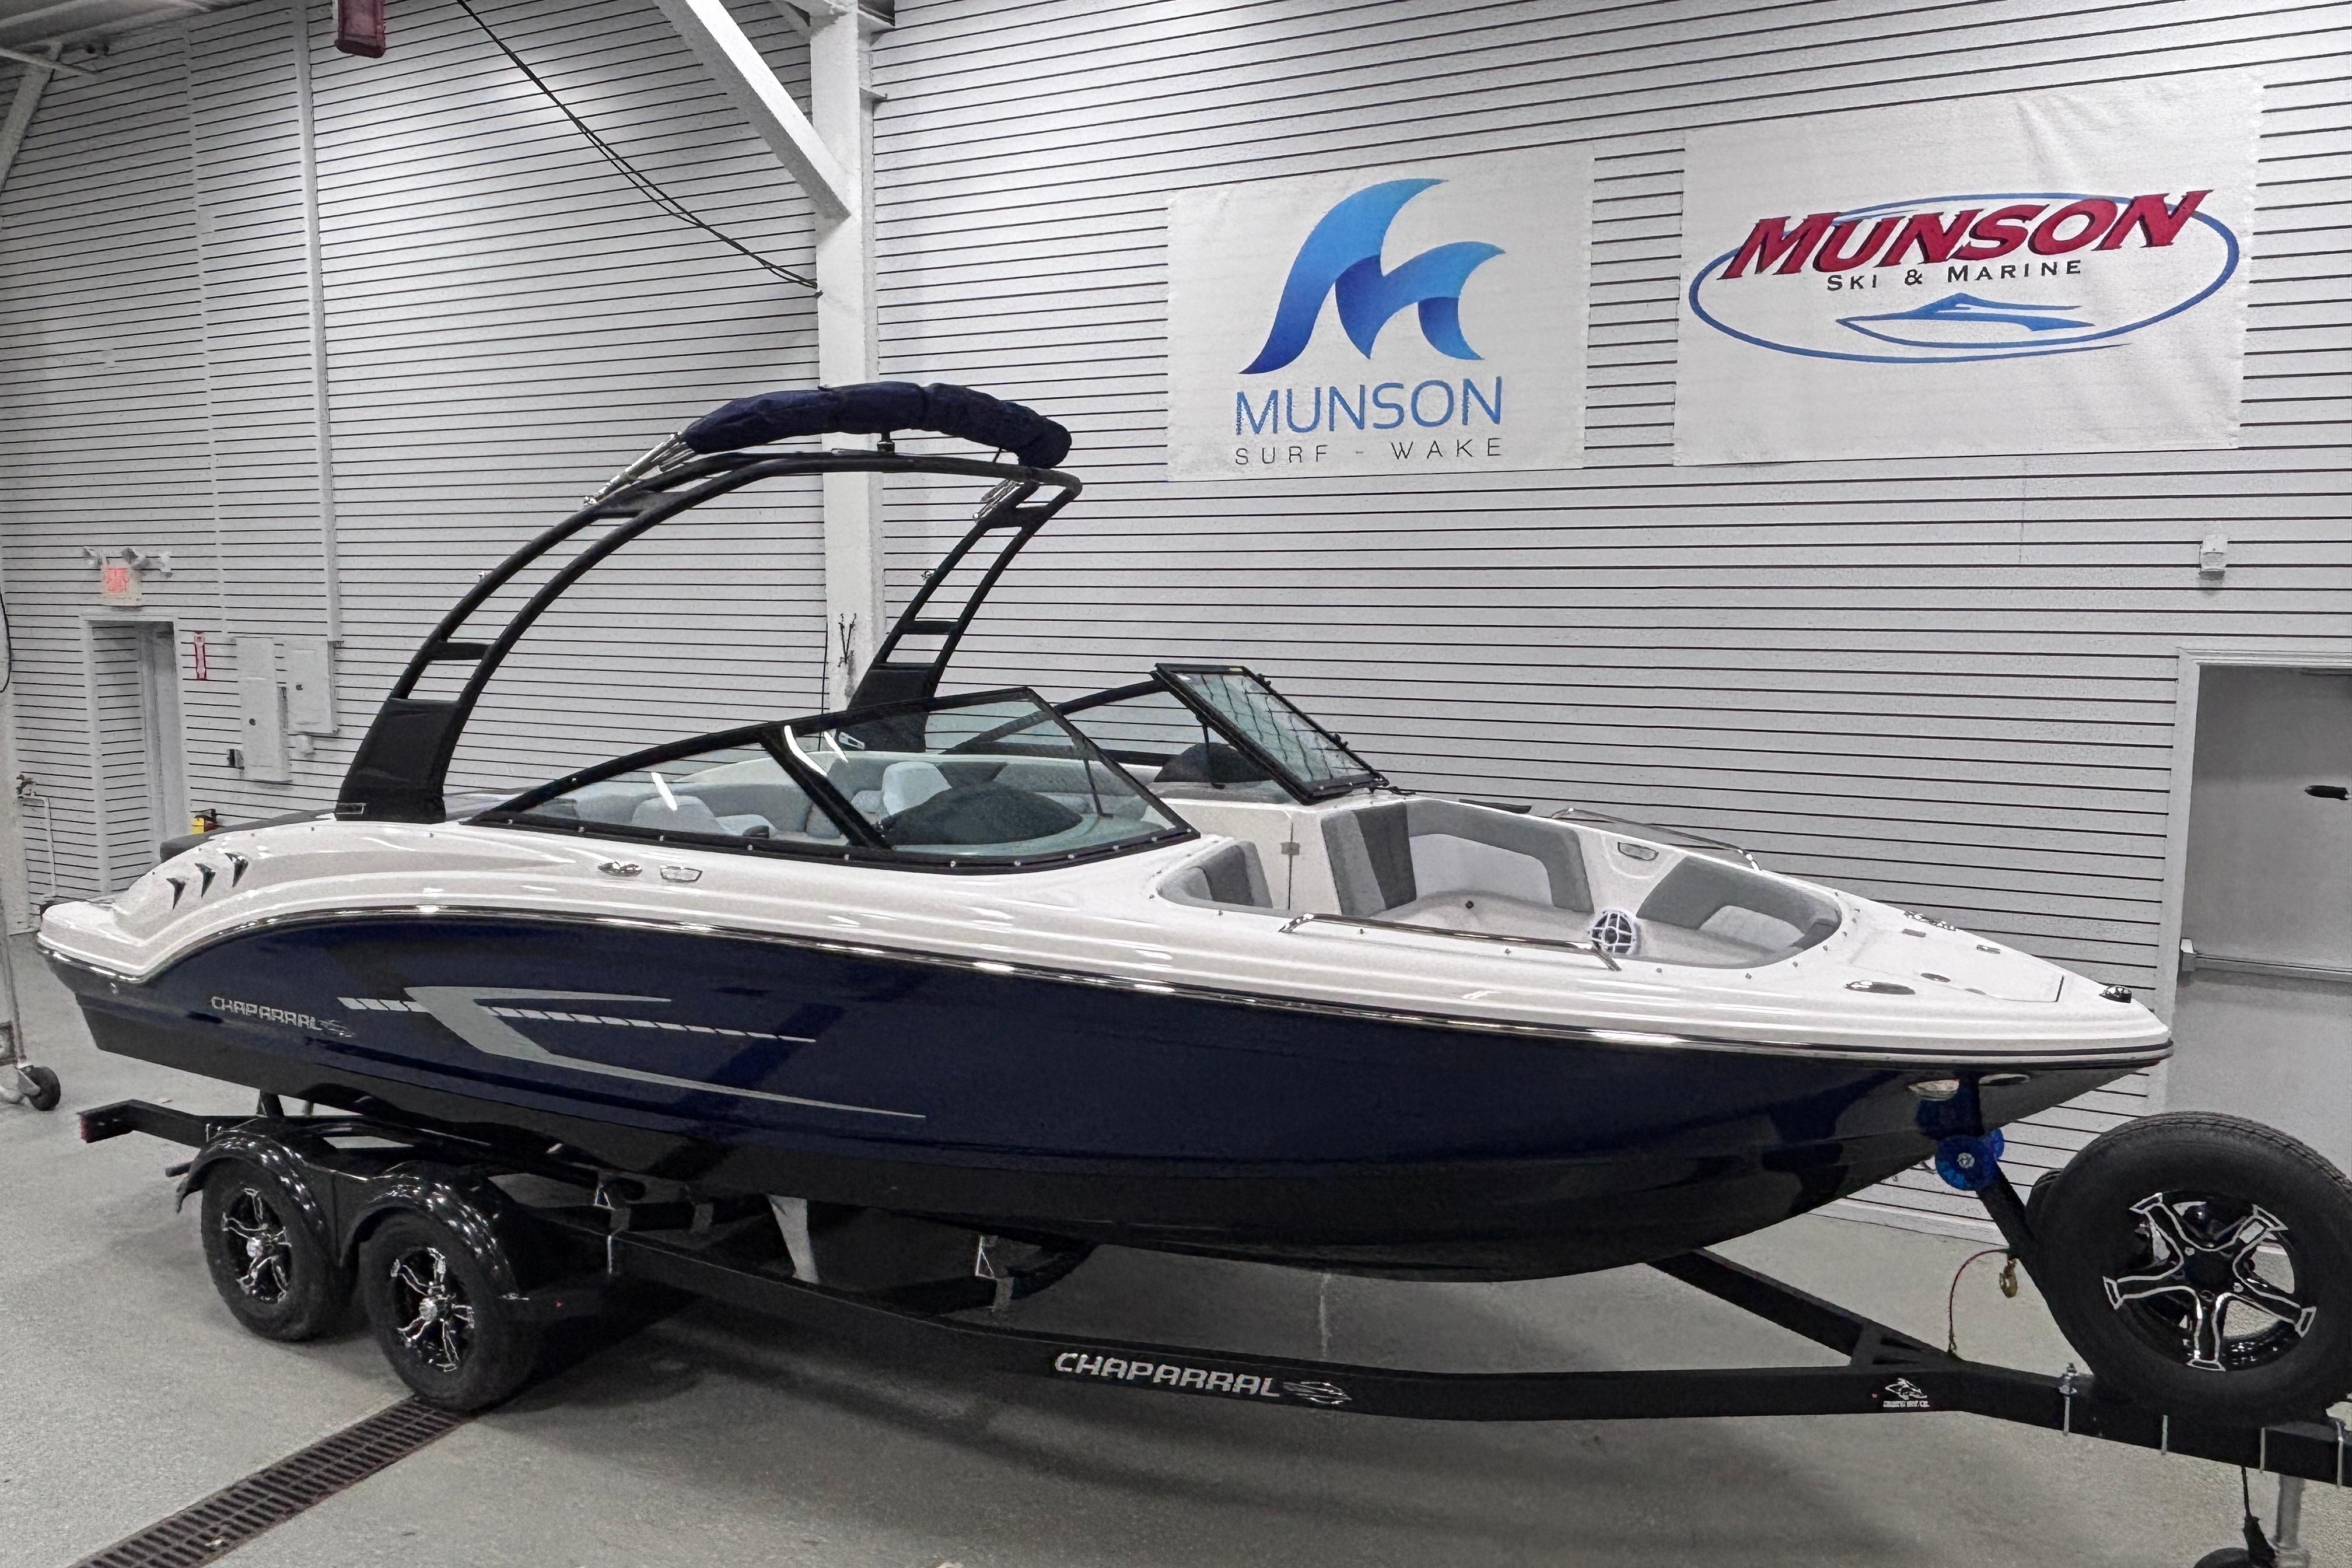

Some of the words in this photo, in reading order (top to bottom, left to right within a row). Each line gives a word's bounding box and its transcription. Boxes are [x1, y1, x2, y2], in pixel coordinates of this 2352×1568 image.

[1716, 189, 2215, 281] MUNSON
[1826, 273, 1878, 292] SKI
[1904, 269, 1923, 286] &
[1947, 259, 2082, 282] MARINE
[1236, 376, 1503, 436] MUNSON
[1235, 444, 1329, 466] SURF
[1390, 438, 1502, 460] WAKE
[210, 996, 323, 1031] CHAPARRAL
[1054, 1352, 1281, 1398] CHAPARRAL
